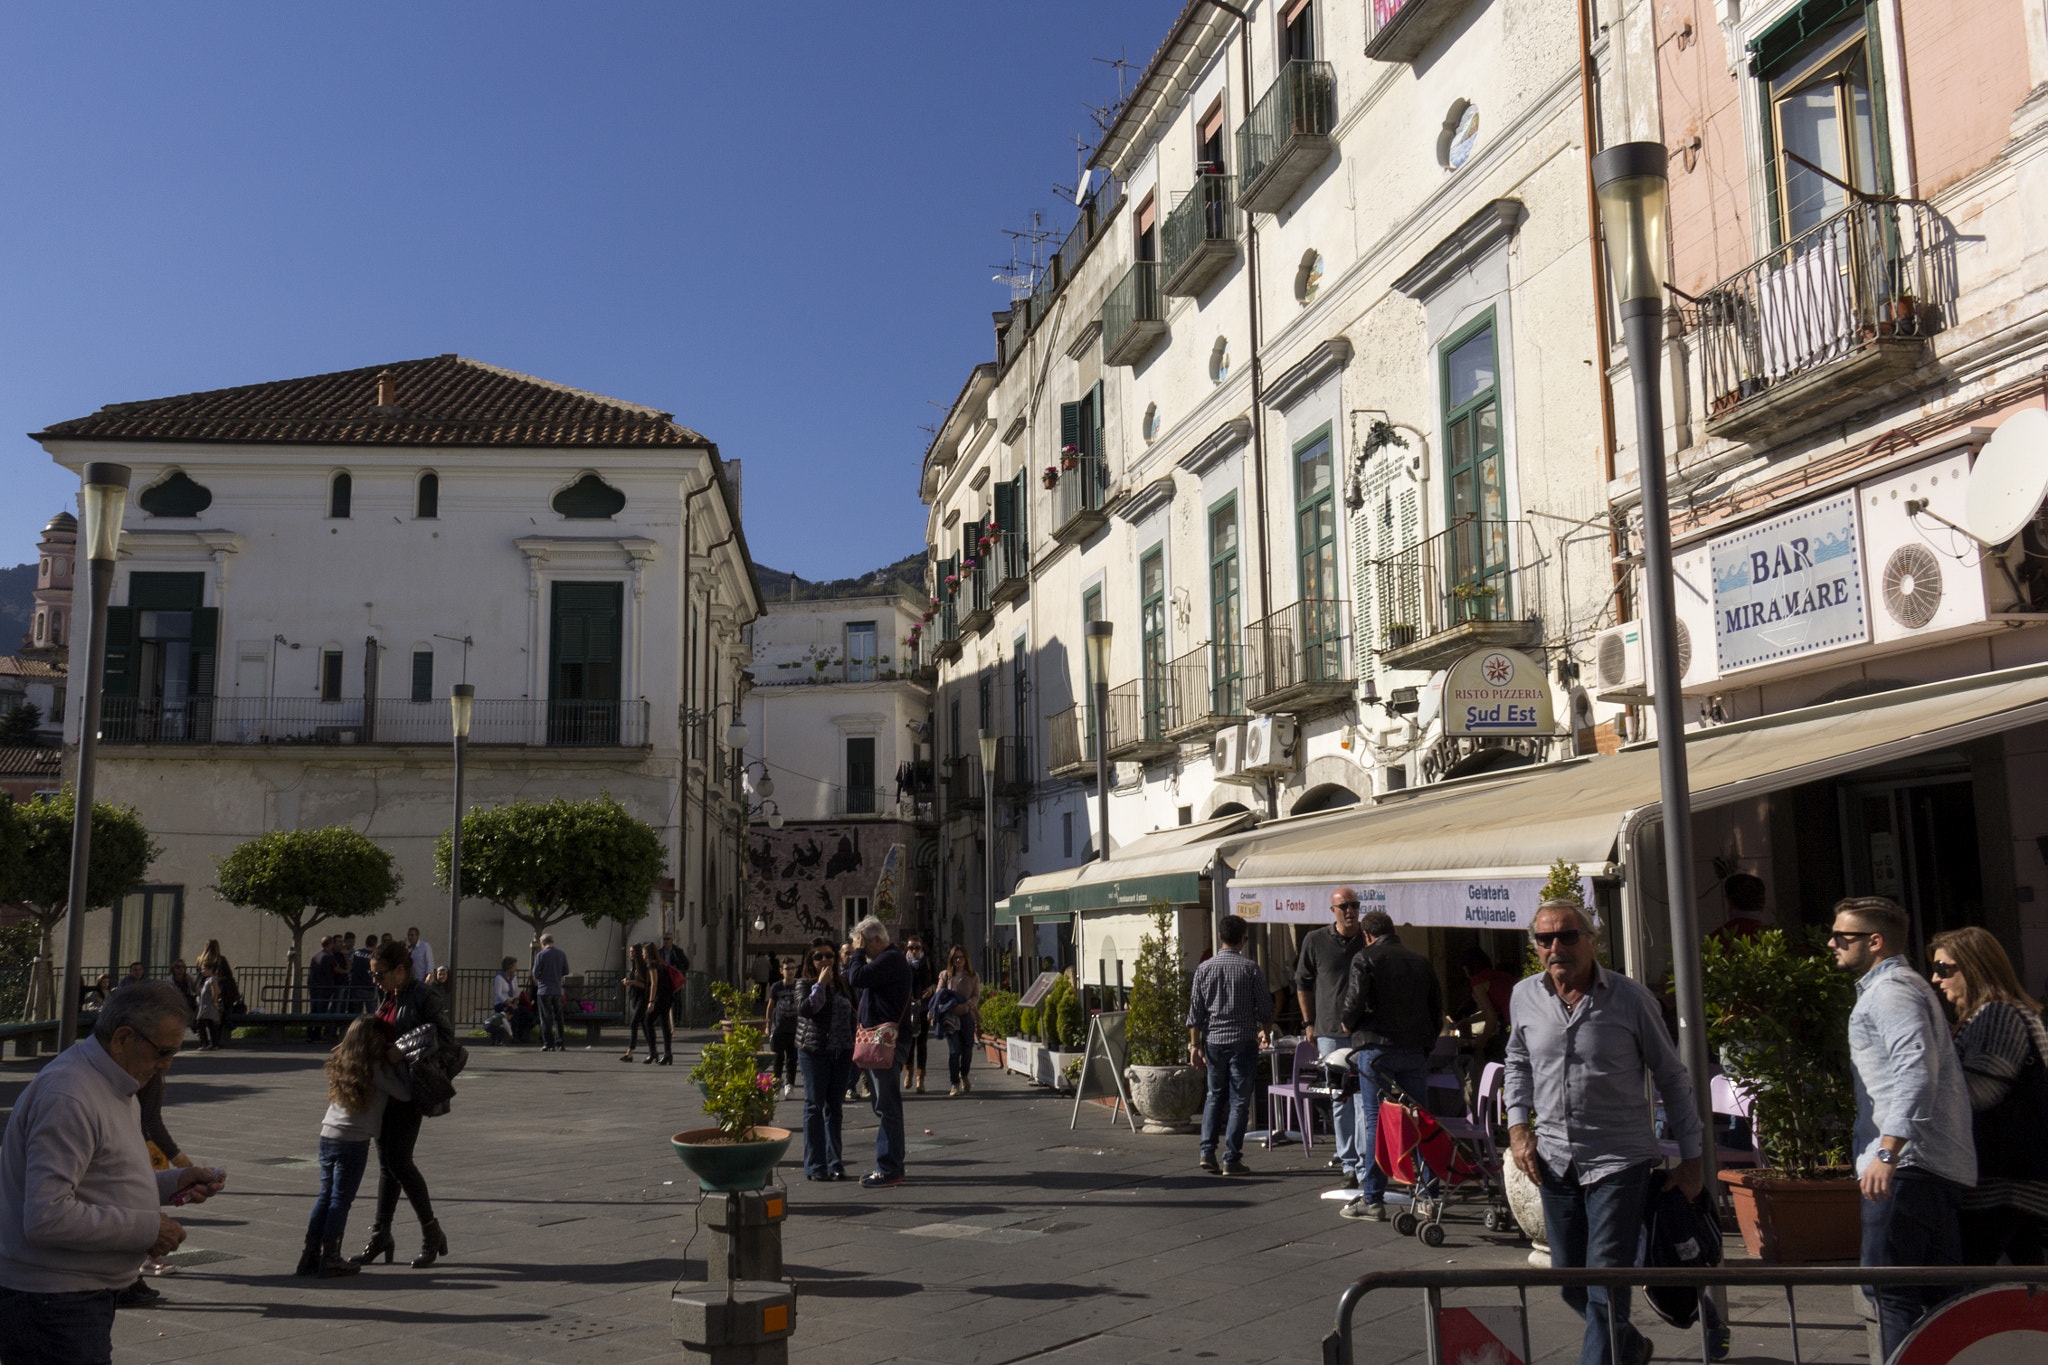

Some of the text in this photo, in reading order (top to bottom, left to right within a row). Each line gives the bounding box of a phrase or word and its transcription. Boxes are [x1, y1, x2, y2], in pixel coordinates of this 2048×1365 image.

[1751, 537, 1813, 584] BAR
[1725, 578, 1849, 633] MIRAMARE
[1455, 689, 1544, 699] RISTO PIZZERIA
[1466, 704, 1536, 723] Sud Est
[1468, 884, 1510, 900] Gelateria
[1275, 899, 1306, 911] La Fonte
